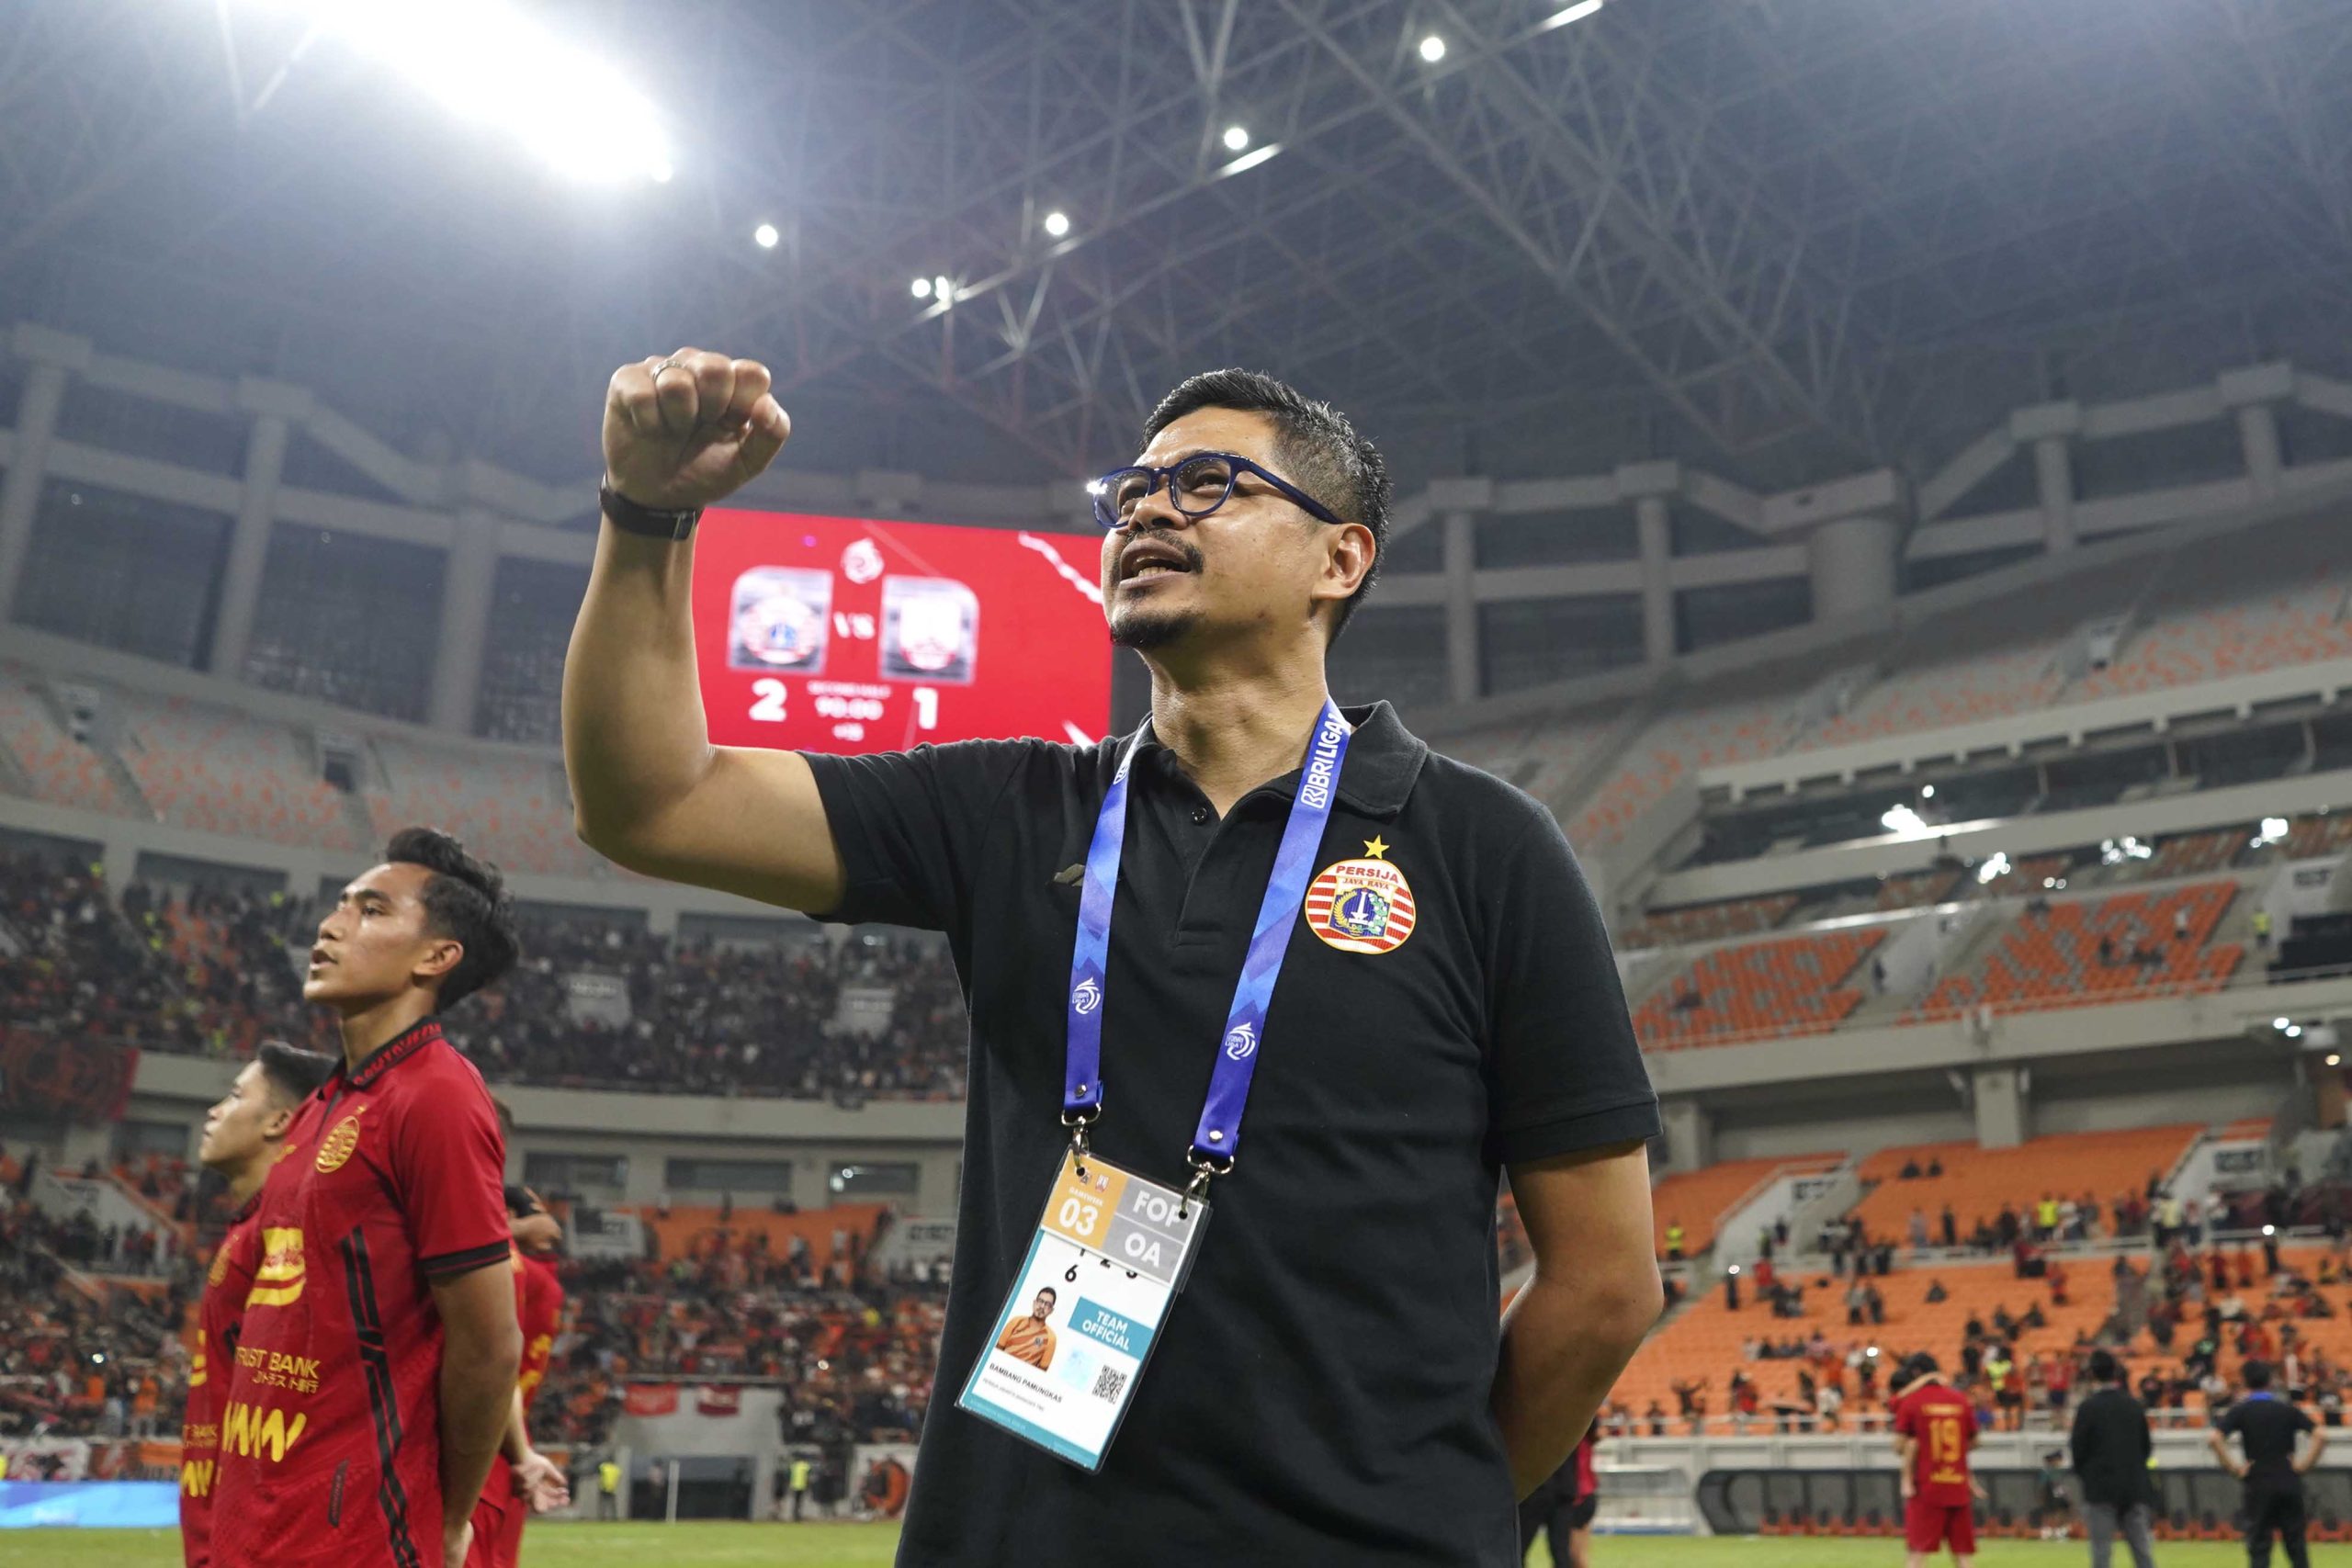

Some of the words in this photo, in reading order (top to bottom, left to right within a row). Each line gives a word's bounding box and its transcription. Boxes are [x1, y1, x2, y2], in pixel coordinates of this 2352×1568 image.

[749, 677, 787, 722] 2
[912, 687, 938, 730] 1
[1316, 722, 1343, 755] LIGA
[1335, 865, 1398, 884] PERSIJA
[1342, 877, 1364, 886] JAYA
[1367, 879, 1389, 890] RAYA
[1059, 1198, 1098, 1235] 03
[1125, 1232, 1161, 1268] OA
[1064, 1264, 1079, 1282] 6
[1081, 1320, 1130, 1351] OFFICIAL
[1096, 1310, 1128, 1334] TEAM
[268, 1351, 321, 1380] BANK
[989, 1362, 1022, 1384] BAMBANG
[1022, 1379, 1063, 1404] PAMUNGKAS
[1929, 1418, 1961, 1462] 19
